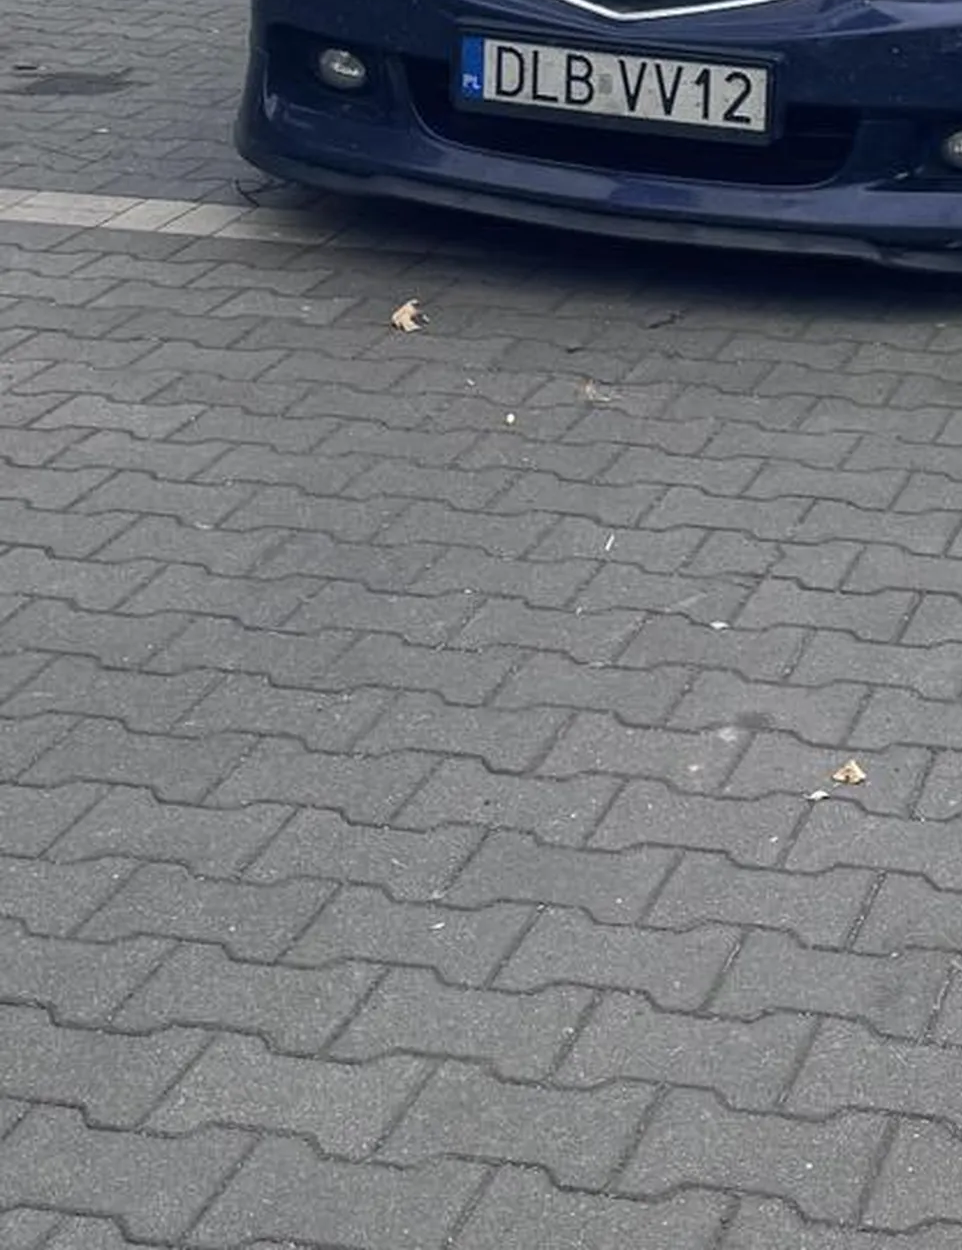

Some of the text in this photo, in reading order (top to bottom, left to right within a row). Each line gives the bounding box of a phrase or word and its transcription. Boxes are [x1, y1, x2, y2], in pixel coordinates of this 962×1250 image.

[463, 73, 481, 90] PL
[495, 45, 751, 125] DLB VV12
